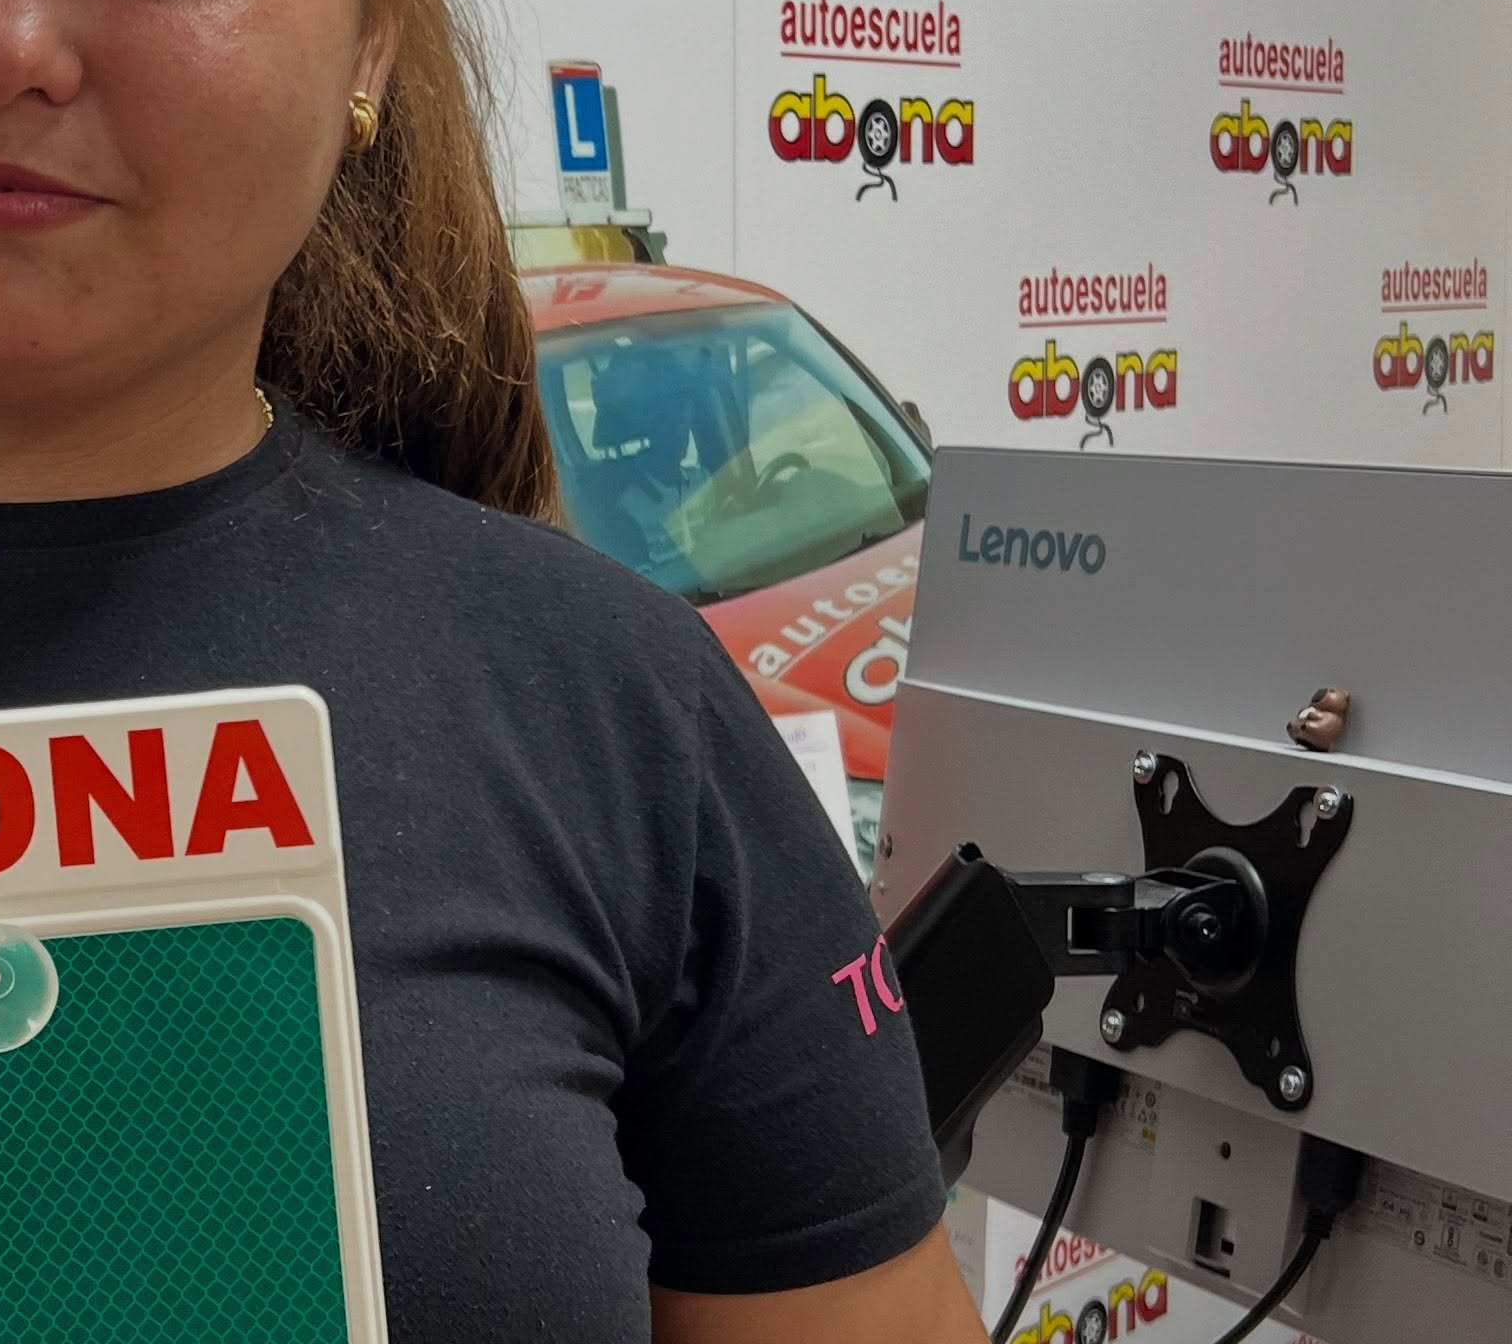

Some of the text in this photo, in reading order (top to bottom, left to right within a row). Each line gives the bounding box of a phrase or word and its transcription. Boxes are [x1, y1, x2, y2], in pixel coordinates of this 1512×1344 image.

[1219, 32, 1344, 85] autoescuela
[564, 83, 596, 158] L
[768, 73, 974, 166] abona
[1209, 98, 1353, 177] abona
[1018, 262, 1168, 317] autoescuela
[1382, 257, 1488, 302] autoescuela
[1008, 339, 1178, 421] abona
[1373, 321, 1495, 391] abona
[958, 513, 1106, 574] Lenovo
